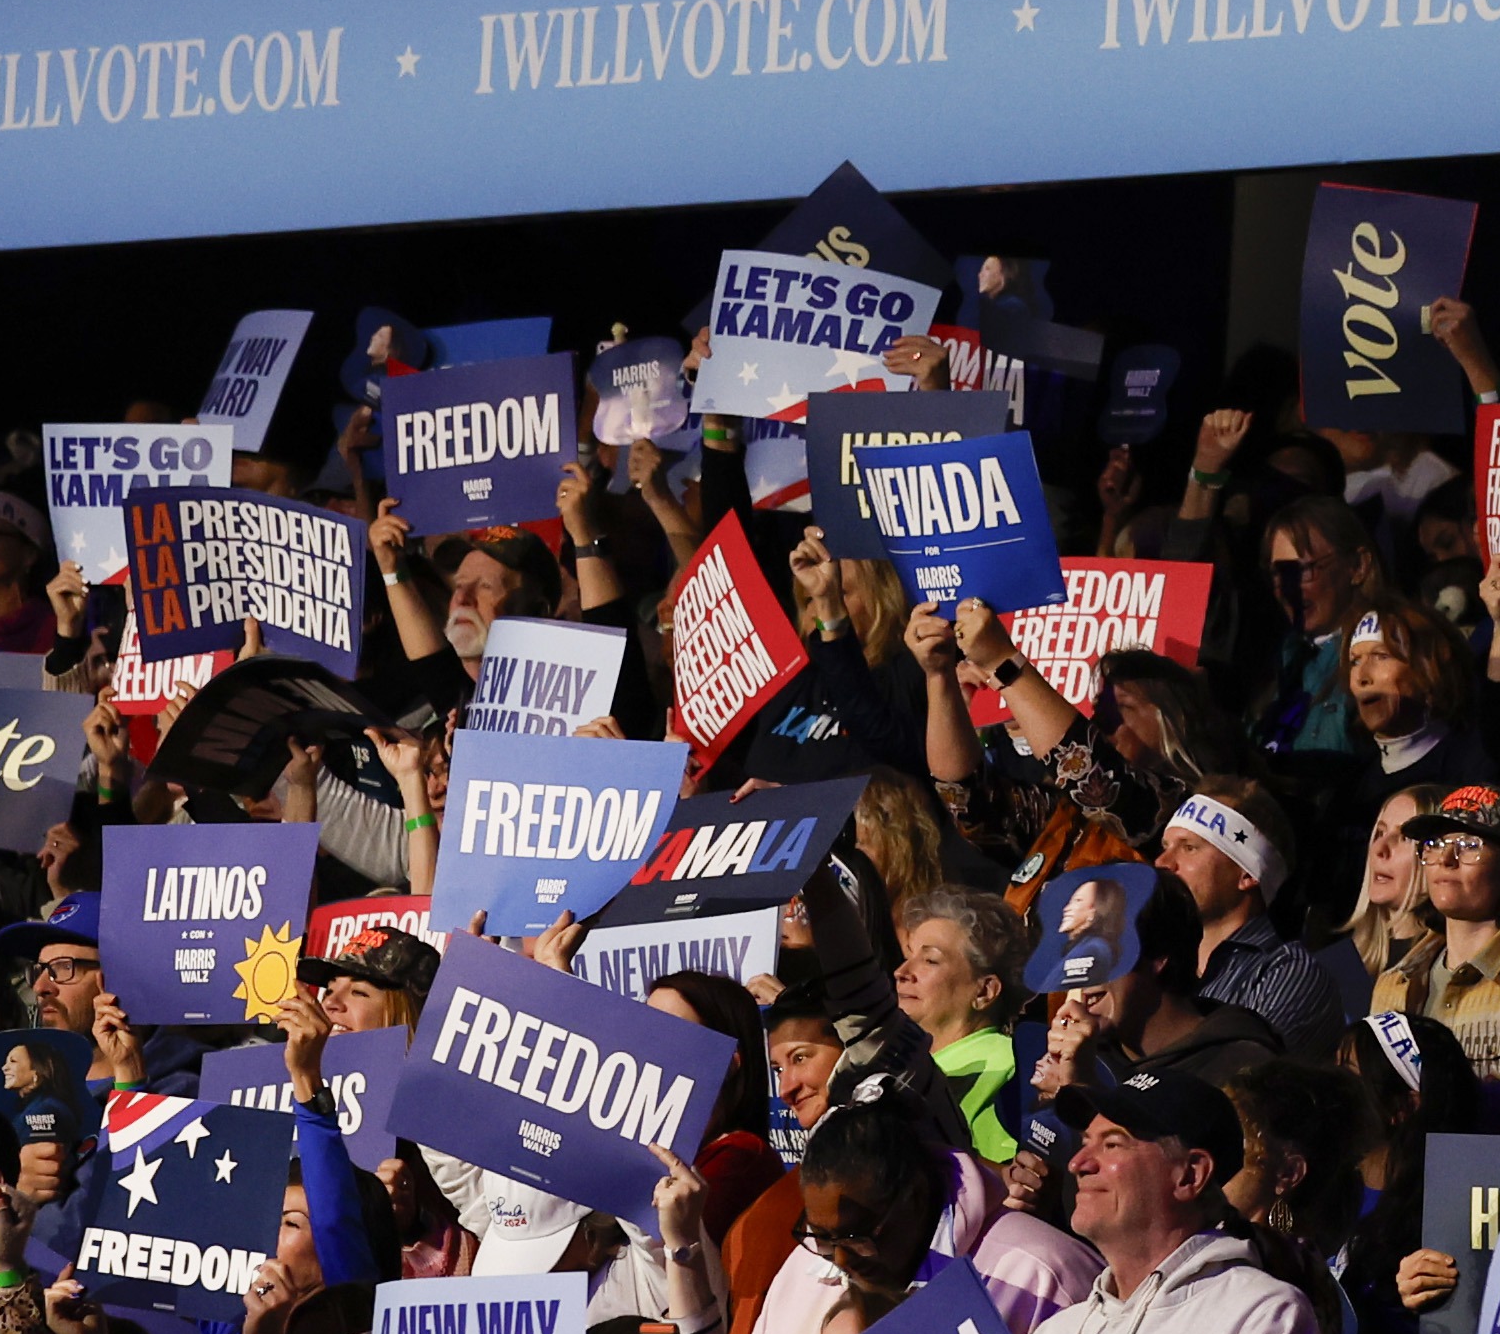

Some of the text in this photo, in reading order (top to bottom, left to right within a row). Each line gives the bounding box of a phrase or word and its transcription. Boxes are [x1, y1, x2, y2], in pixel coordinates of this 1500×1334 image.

[723, 265, 915, 322] LET'S GO
[1331, 221, 1406, 401] vote
[715, 302, 904, 357] KAMALA
[239, 339, 287, 377] WAY
[612, 360, 660, 388] HARRIS
[396, 395, 560, 474] FREEDOM
[50, 438, 213, 470] LET'S GO
[463, 478, 493, 494] HARRIS
[467, 491, 489, 501] WALZ
[866, 457, 1022, 539] NEVADA
[131, 500, 352, 566] LA PRESIDENTA
[924, 546, 940, 556] FOR
[136, 543, 352, 610] LA PRESIDENTA
[915, 566, 961, 589] HARRIS
[926, 588, 957, 603] WALZ
[141, 585, 352, 652] LA PRESIDENTA
[521, 658, 596, 714] WAY
[680, 632, 777, 747] FREEDOM
[459, 779, 661, 862] FREEDOM
[144, 866, 267, 921] LATINOS
[535, 879, 567, 895] HARRIS
[537, 893, 558, 903] WALZ
[174, 948, 215, 970] HARRIS
[180, 967, 210, 984] WALZ
[432, 986, 696, 1148] FREEDOM
[518, 1119, 562, 1150] HARRIS
[523, 1134, 551, 1158] WALZ
[502, 1217, 528, 1228] 2024
[78, 1228, 265, 1297] FREEDOM
